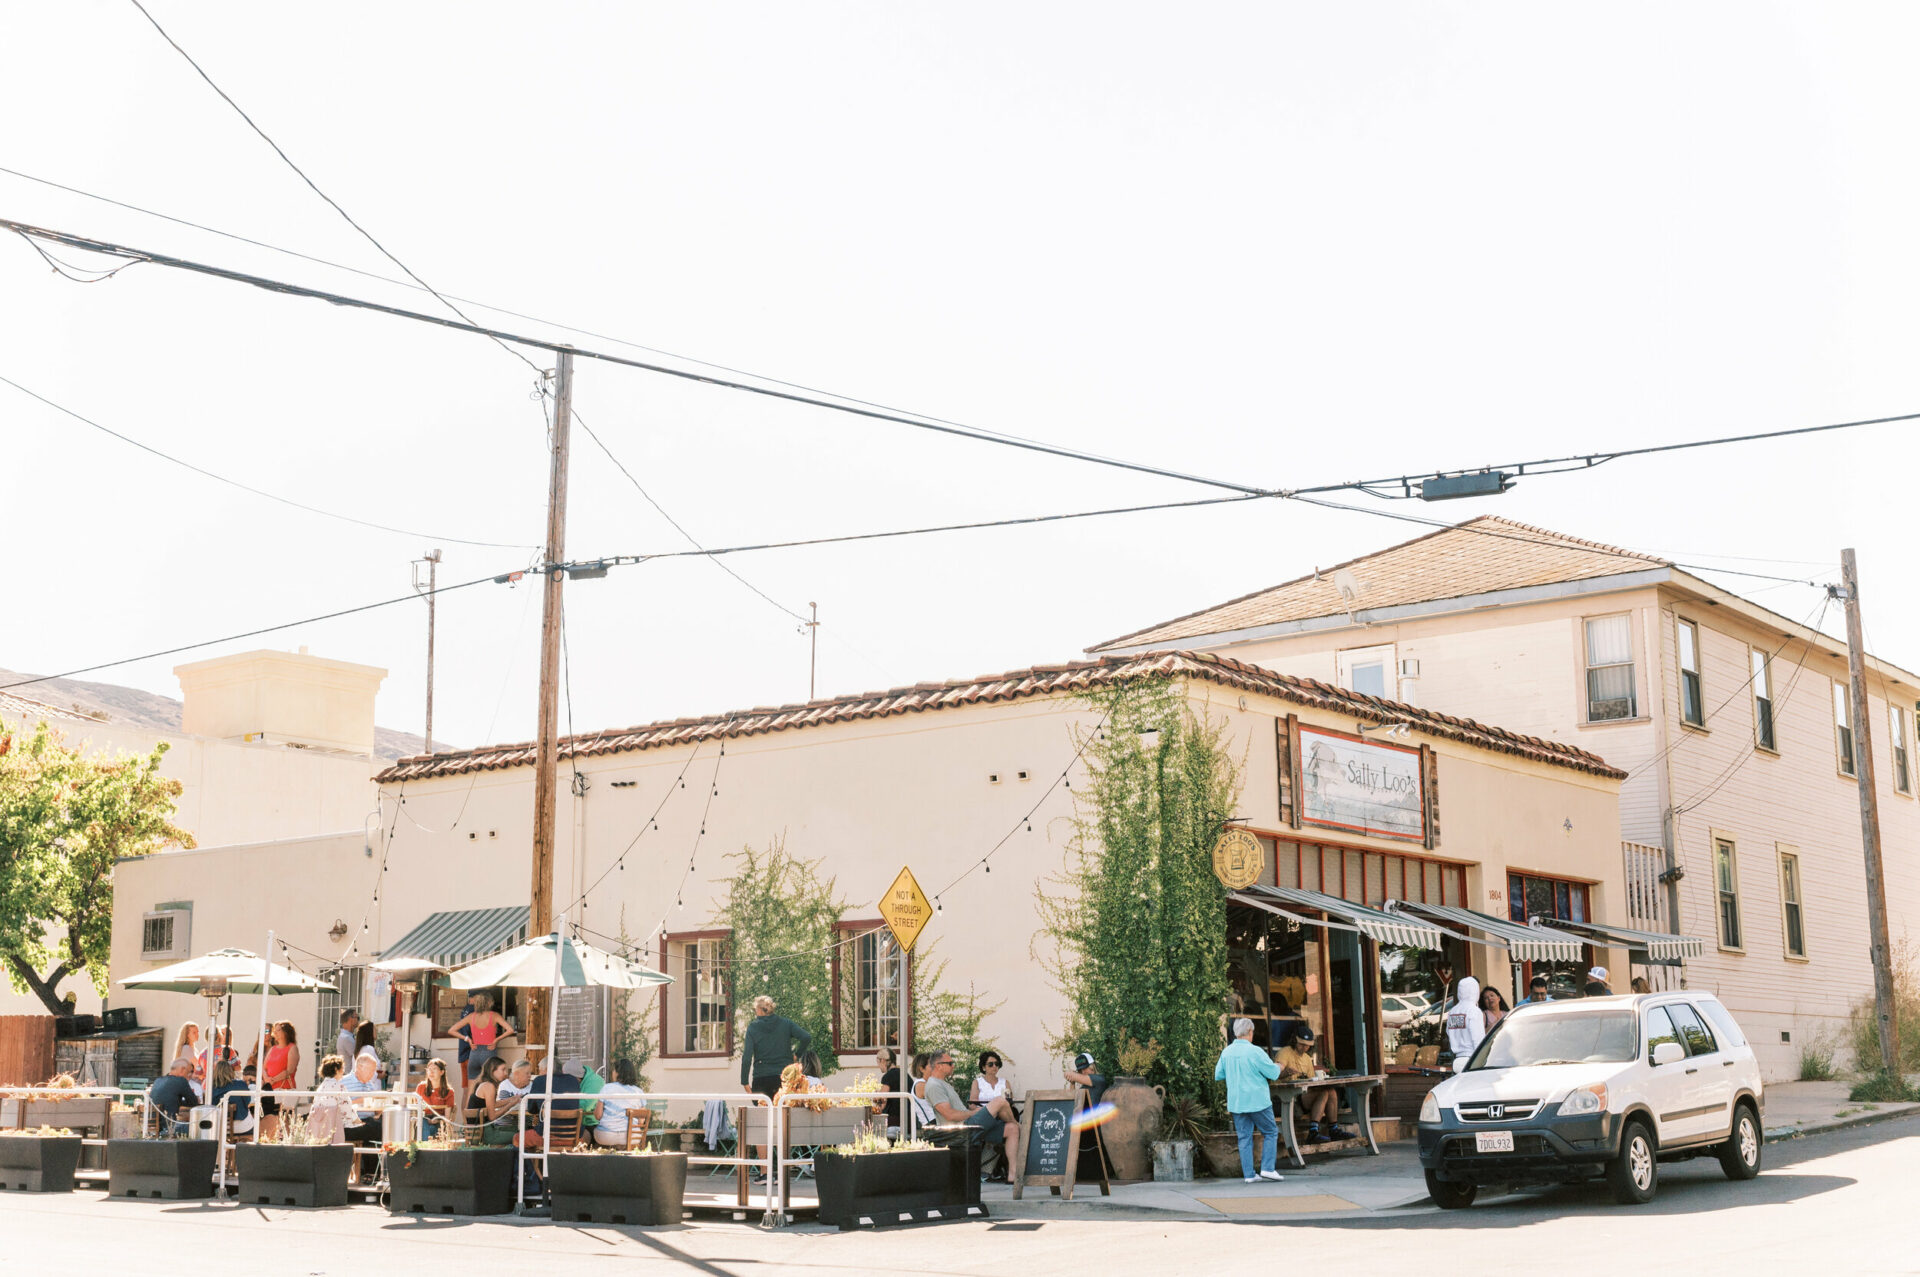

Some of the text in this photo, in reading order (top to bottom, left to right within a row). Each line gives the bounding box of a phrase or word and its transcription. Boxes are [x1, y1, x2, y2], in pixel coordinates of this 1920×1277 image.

[1347, 760, 1379, 795] Sally
[1383, 766, 1416, 794] Loo's
[1218, 834, 1236, 854] SALLY
[896, 890, 916, 901] NOT A
[1489, 890, 1502, 902] 1804
[891, 903, 921, 915] THROUGH
[894, 917, 918, 928] STREET
